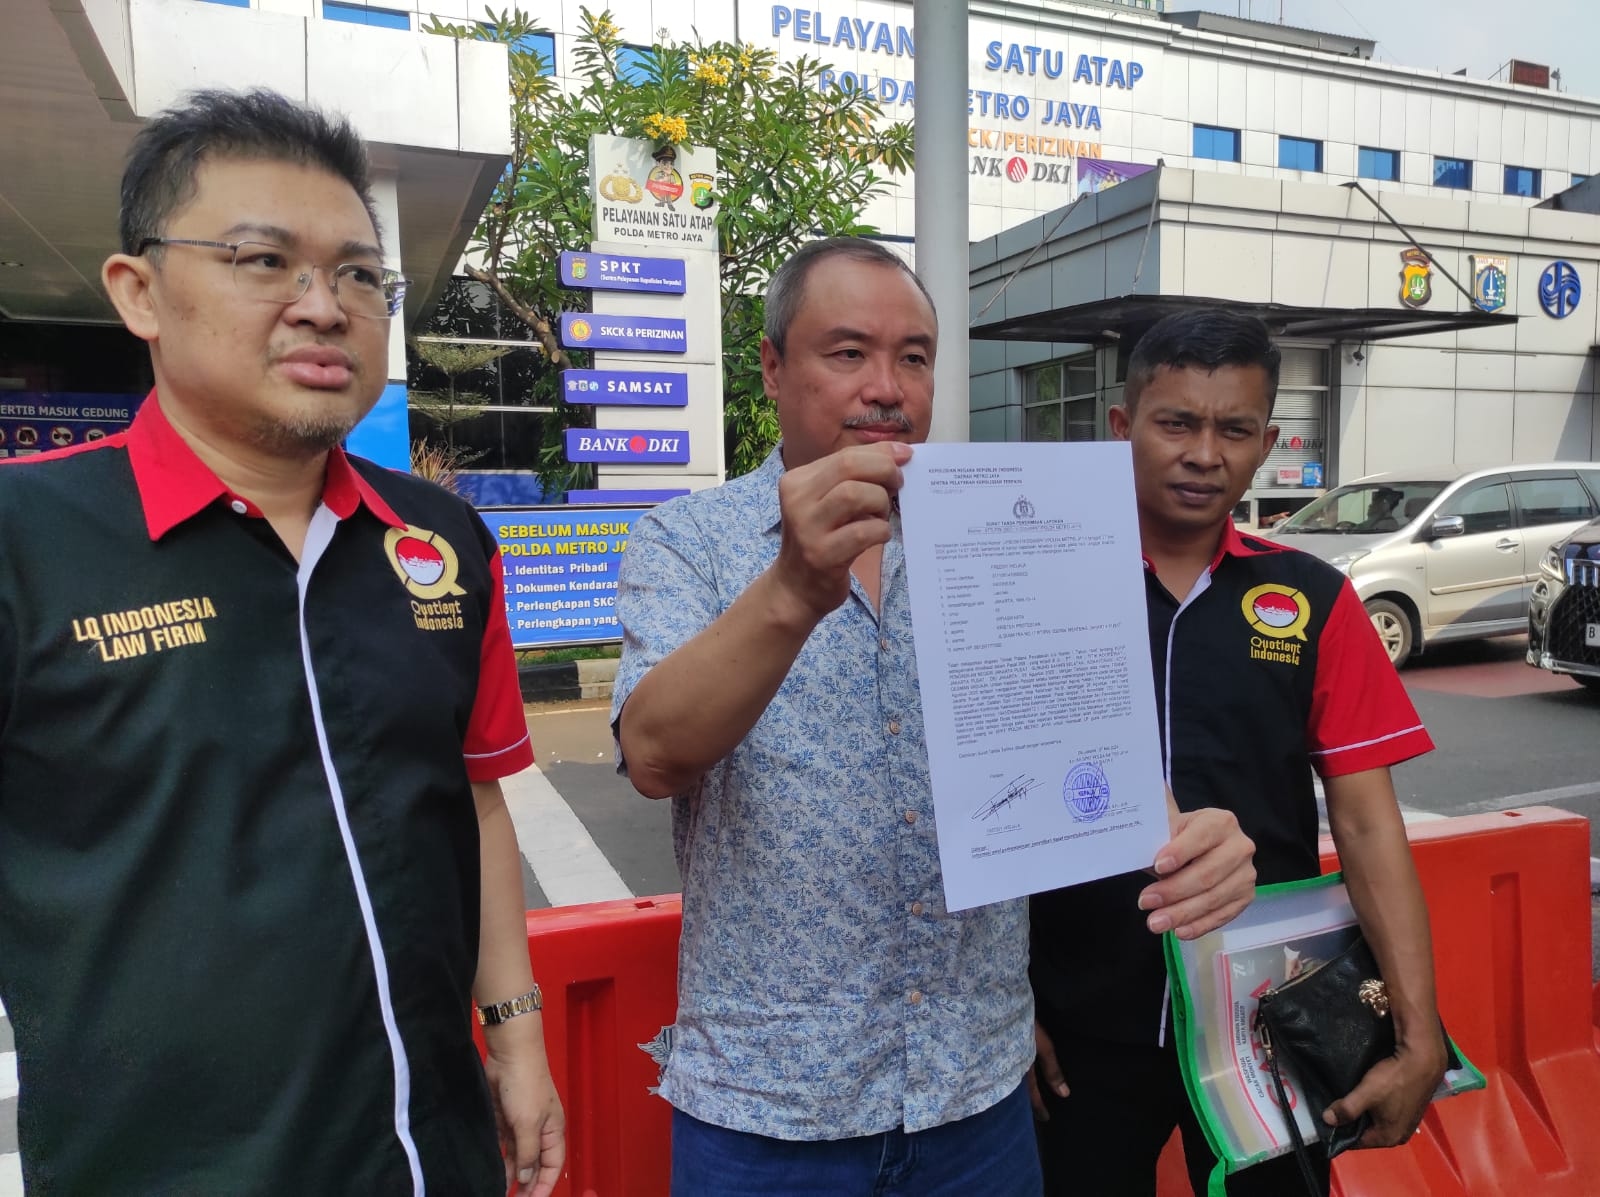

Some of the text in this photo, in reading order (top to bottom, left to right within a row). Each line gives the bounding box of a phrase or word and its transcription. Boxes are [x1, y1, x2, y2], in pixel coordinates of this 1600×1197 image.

[772, 5, 1144, 90] PELAYAN SATU ATAP
[969, 89, 1030, 121] ETRO
[1041, 100, 1102, 130] JAYA
[969, 129, 1102, 159] CK/PERIZINAN
[1031, 161, 1071, 185] DKI
[602, 207, 713, 231] PELAYANAN SATU ATAP
[614, 227, 703, 243] POLDA METRO JAYA
[600, 260, 641, 274] SPKT
[600, 326, 684, 340] SKCK & PERIZINAN
[607, 380, 673, 394] SAMSAT
[0, 405, 129, 418] ERTIB MASUK GEDUNG
[578, 437, 680, 453] BANK DKI
[498, 522, 630, 539] SEBELUM MASUK
[499, 540, 627, 557] POLDA METRO JA
[515, 565, 565, 576] Identitas
[570, 562, 608, 574] Pribadi
[516, 582, 566, 594] Dokumen
[569, 581, 619, 592] Kendaraa
[517, 600, 591, 615] Perlengkapan
[593, 597, 616, 607] SKC
[72, 597, 217, 642] LQ INDONESIA
[414, 613, 464, 631] Indonesia
[517, 618, 591, 633] Perlengkapan
[593, 616, 618, 628] yang
[1588, 626, 1596, 639] B
[100, 621, 207, 662] LAW FIRM
[1250, 636, 1302, 654] Quotient
[1250, 646, 1301, 666] Indonesia
